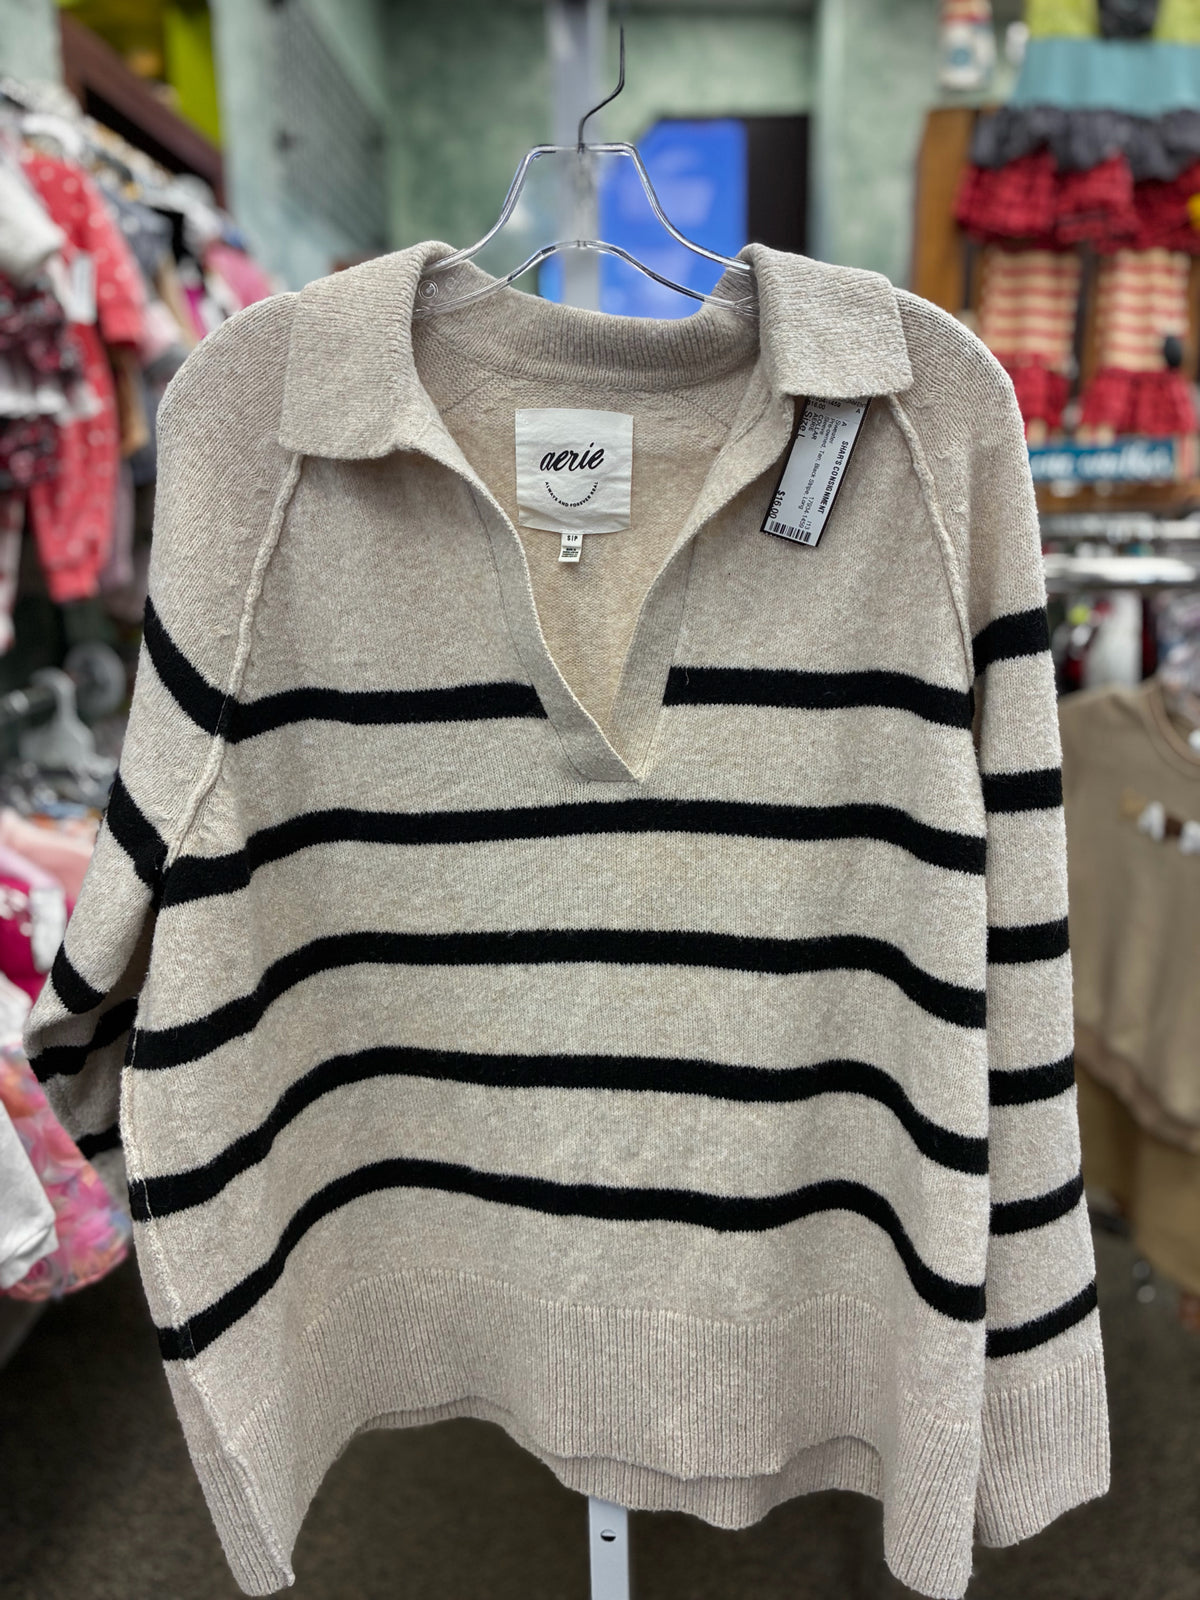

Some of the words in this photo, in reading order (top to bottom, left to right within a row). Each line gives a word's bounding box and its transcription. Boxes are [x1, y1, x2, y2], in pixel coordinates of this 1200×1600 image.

[799, 411, 813, 432] Size
[811, 414, 823, 440] COLLAR
[540, 442, 604, 471] aerie
[835, 440, 849, 466] SHAR'S
[545, 482, 558, 501] ALWAYS
[570, 495, 591, 507] FOREVER
[590, 482, 598, 495] REAL
[818, 466, 840, 514] CONSIGNMENT
[769, 490, 786, 519] $16.00
